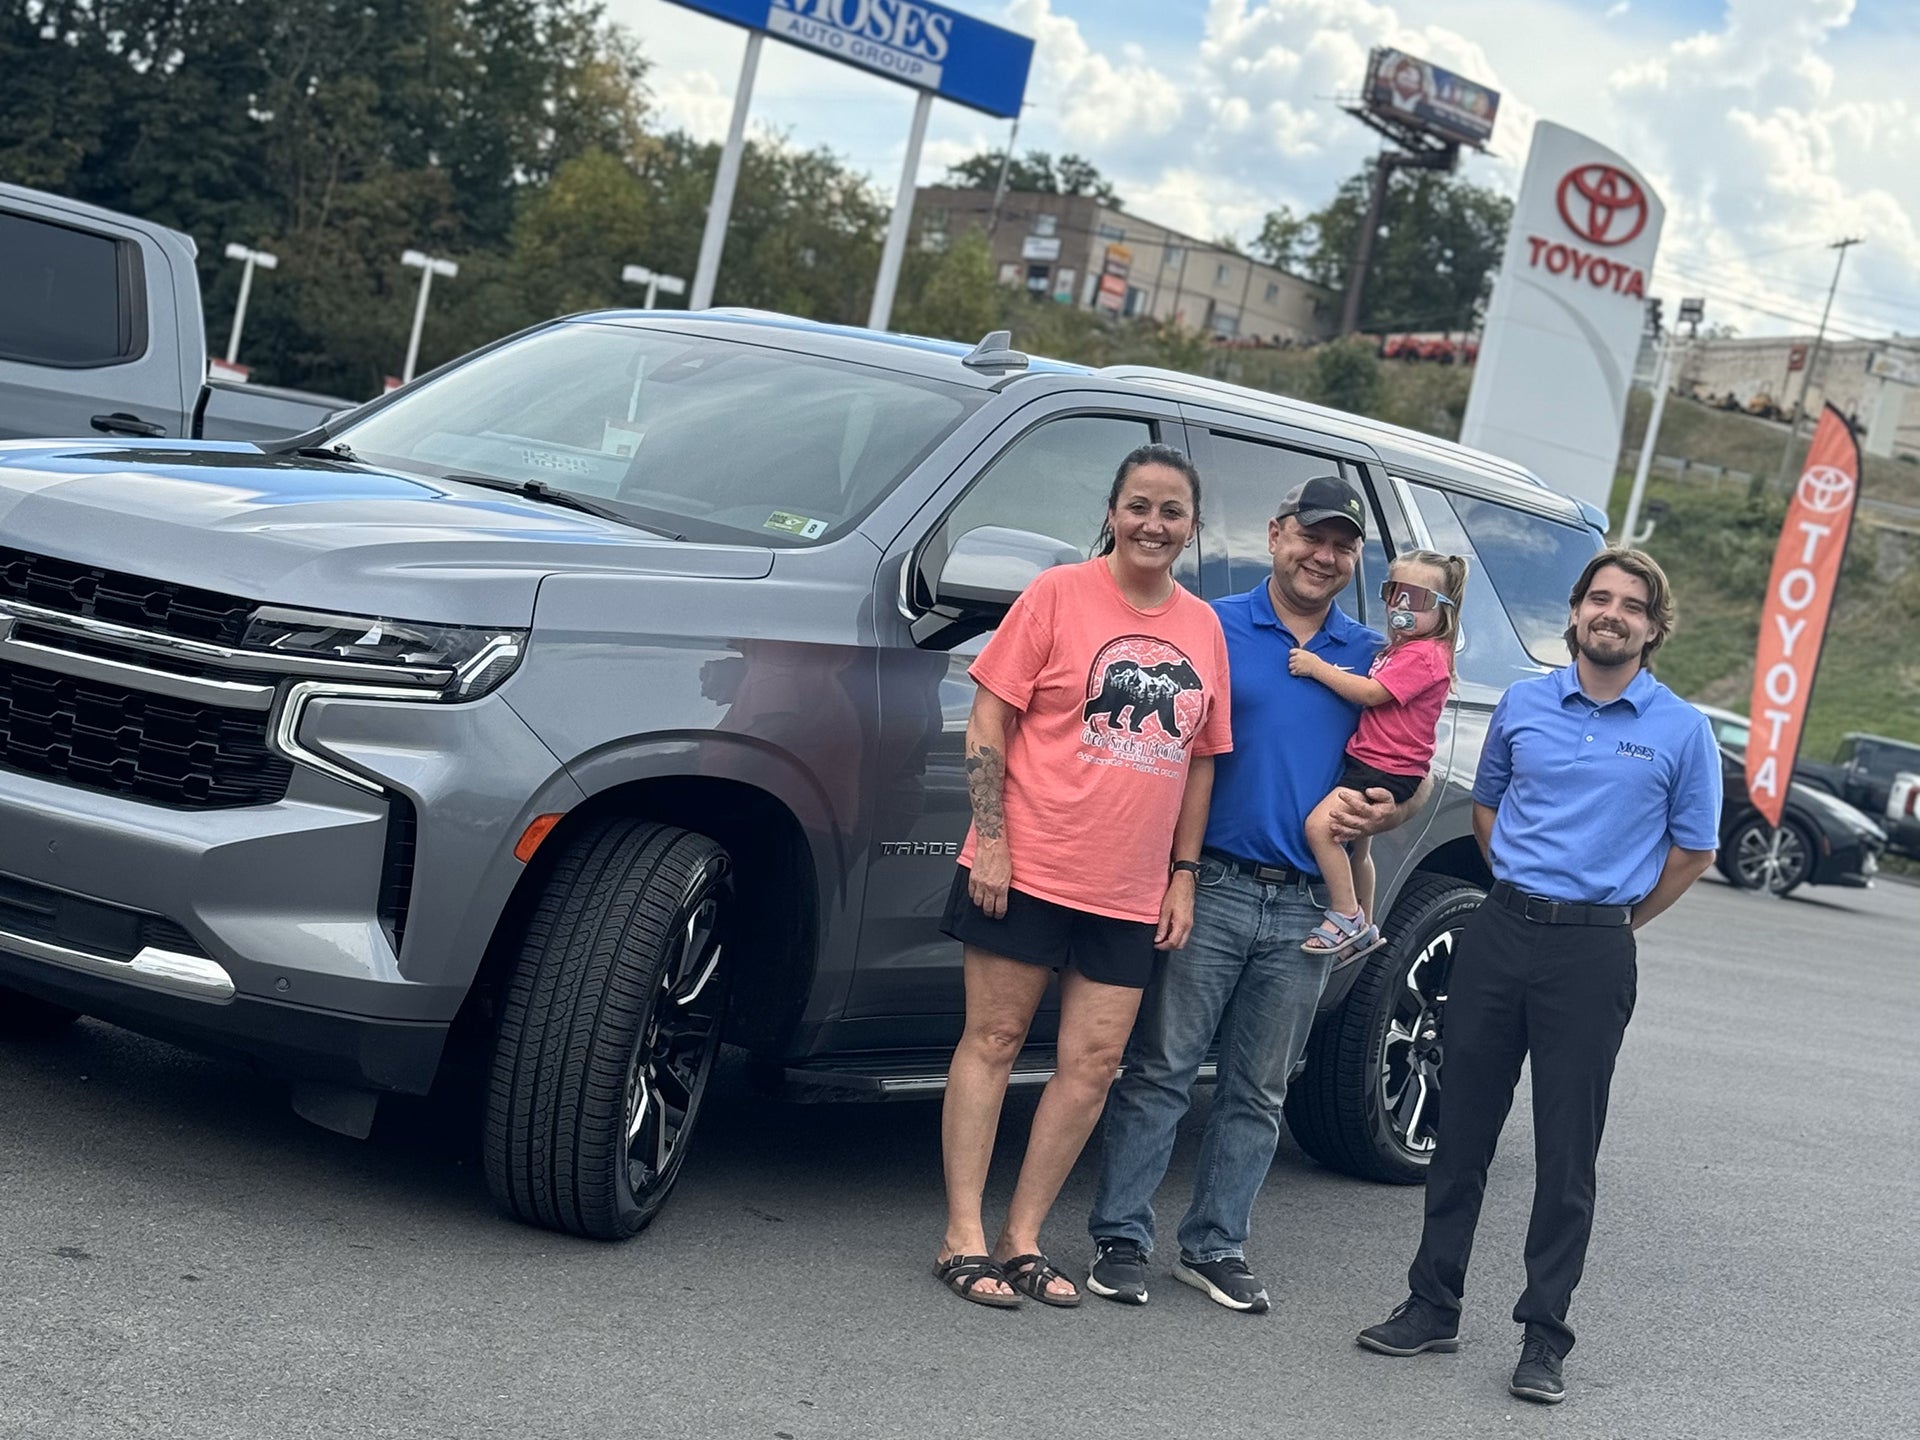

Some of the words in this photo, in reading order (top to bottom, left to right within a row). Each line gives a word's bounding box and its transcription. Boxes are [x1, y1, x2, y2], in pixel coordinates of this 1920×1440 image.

[787, 18, 844, 49] AUTO
[850, 41, 924, 76] GROUP
[1526, 235, 1645, 300] TOYOTA
[1750, 522, 1830, 798] TOYOTA
[1616, 740, 1656, 757] MOSES
[880, 841, 958, 856] TAHOE
